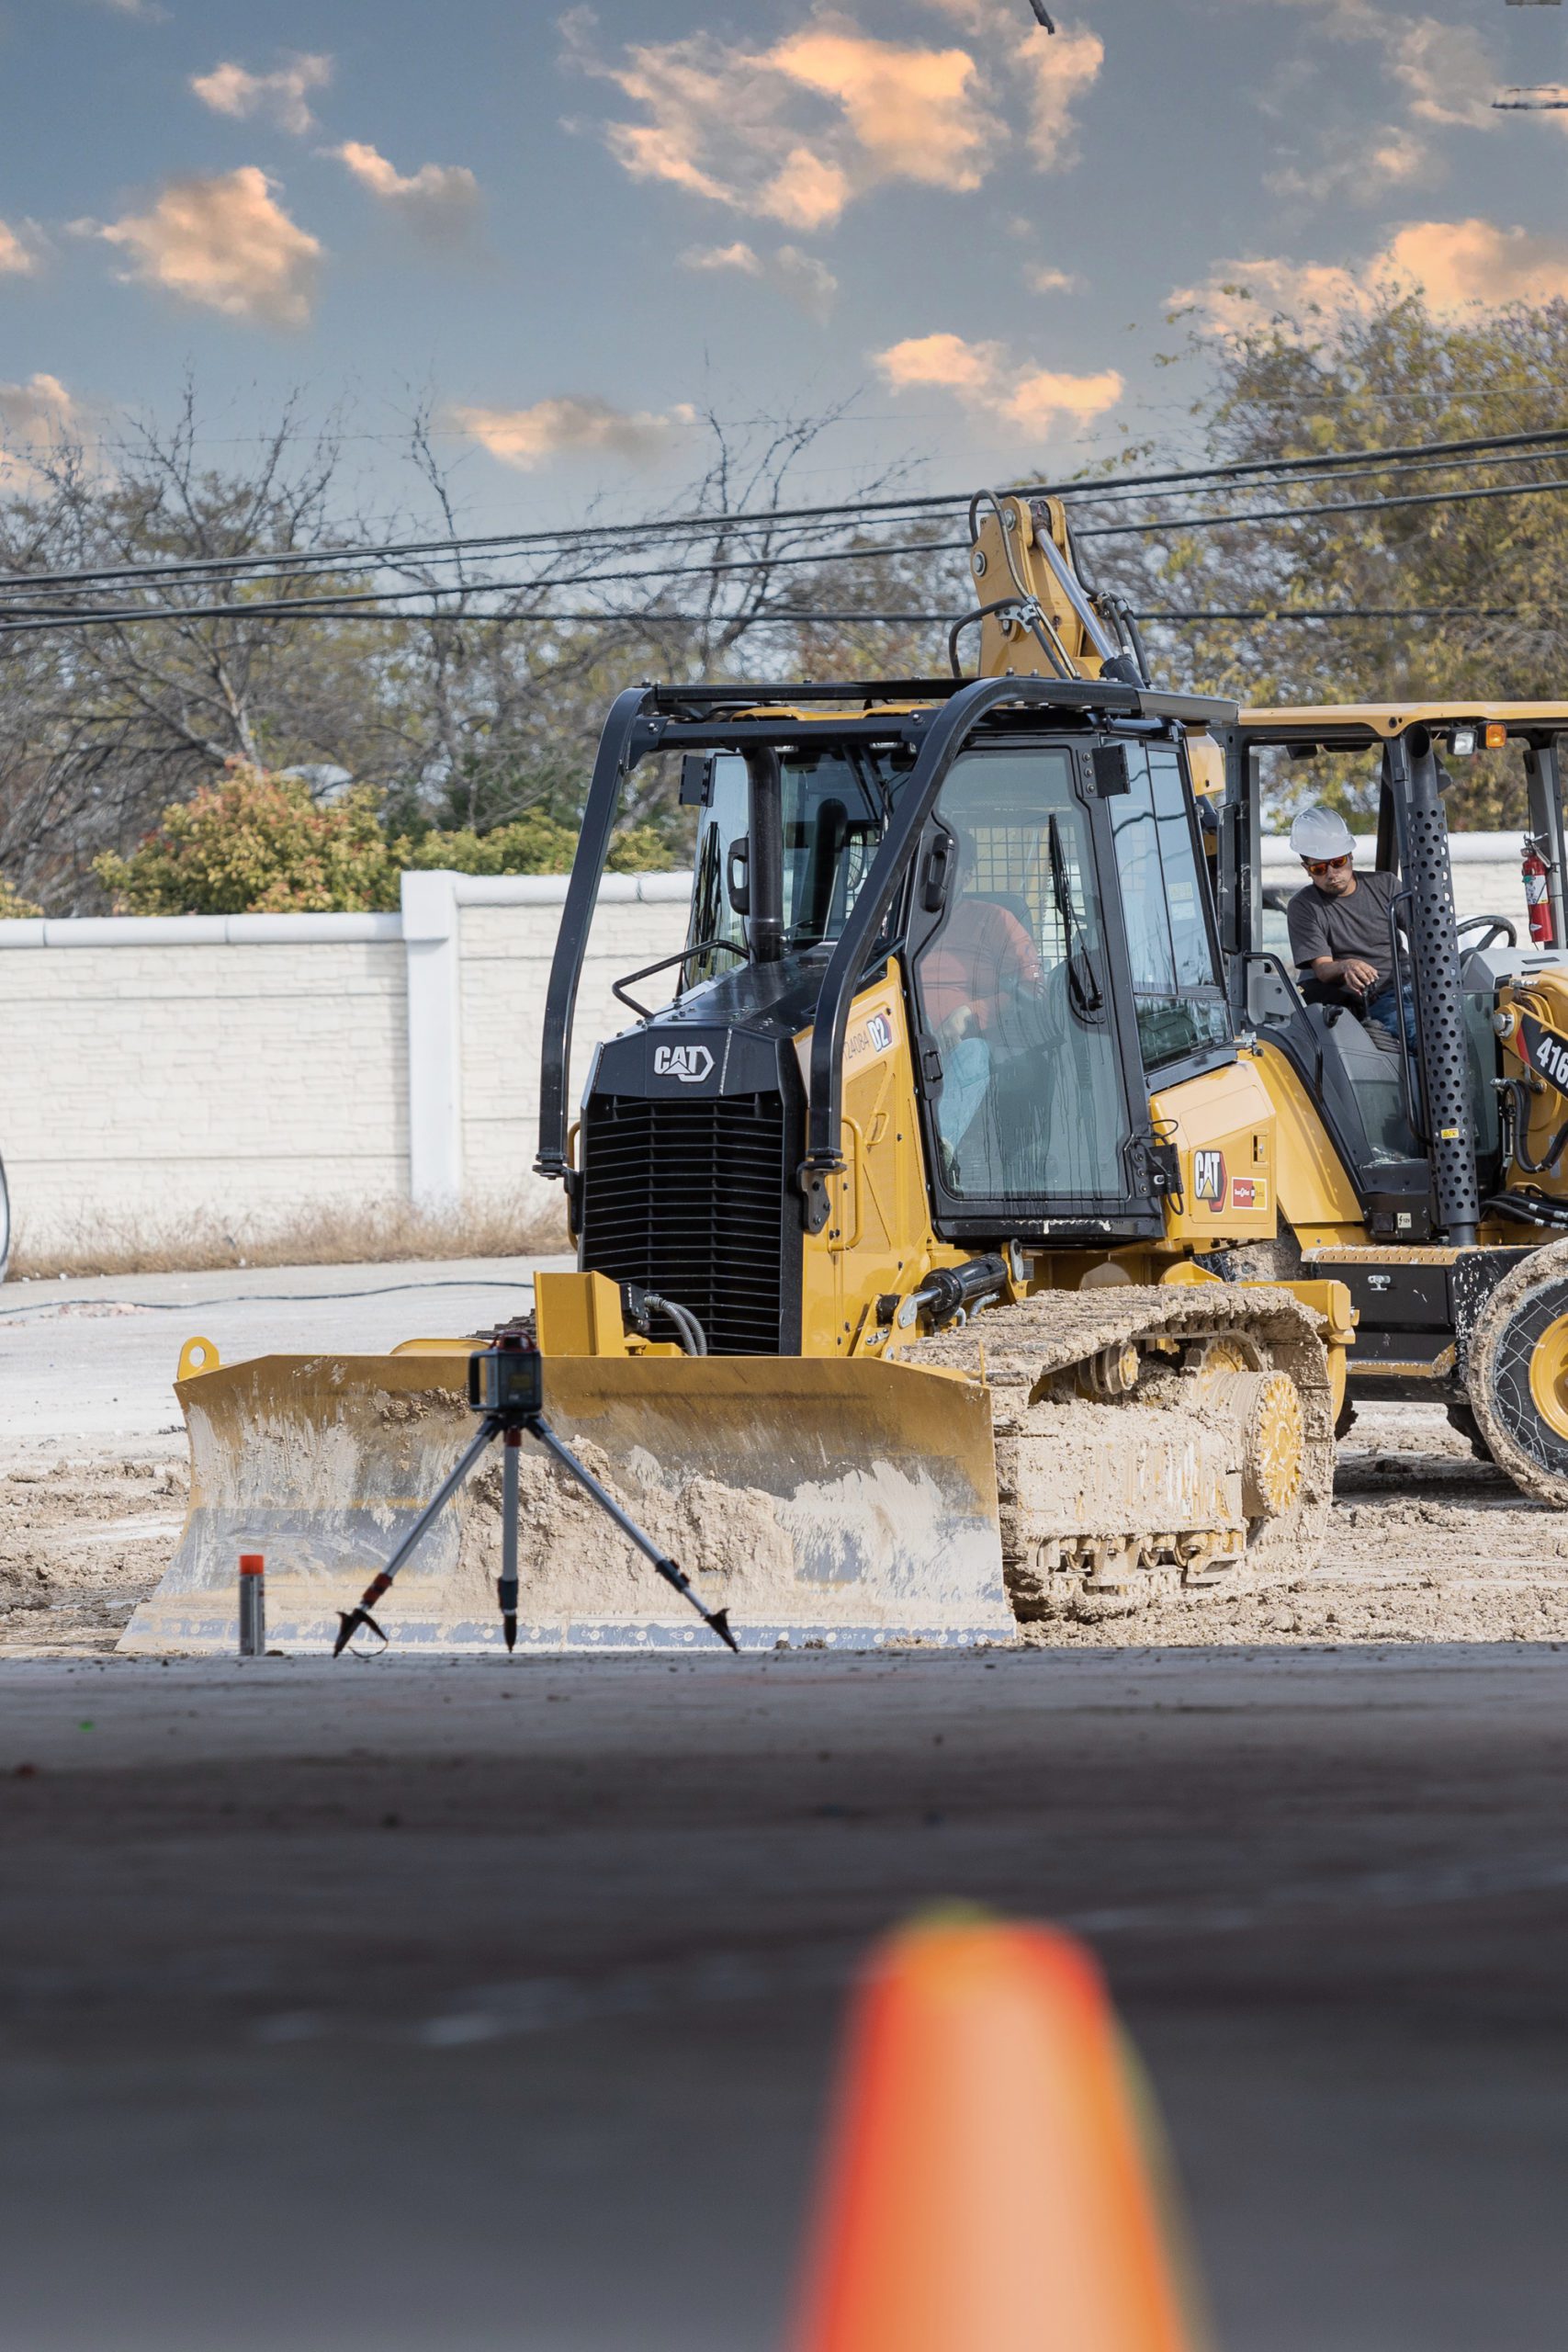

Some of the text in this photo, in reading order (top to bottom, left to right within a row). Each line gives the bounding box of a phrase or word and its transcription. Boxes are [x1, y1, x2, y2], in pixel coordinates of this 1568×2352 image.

[867, 1016, 889, 1052] D2
[654, 1046, 707, 1075] CAT
[1536, 1036, 1568, 1089] 416
[1195, 1151, 1221, 1198] CAT
